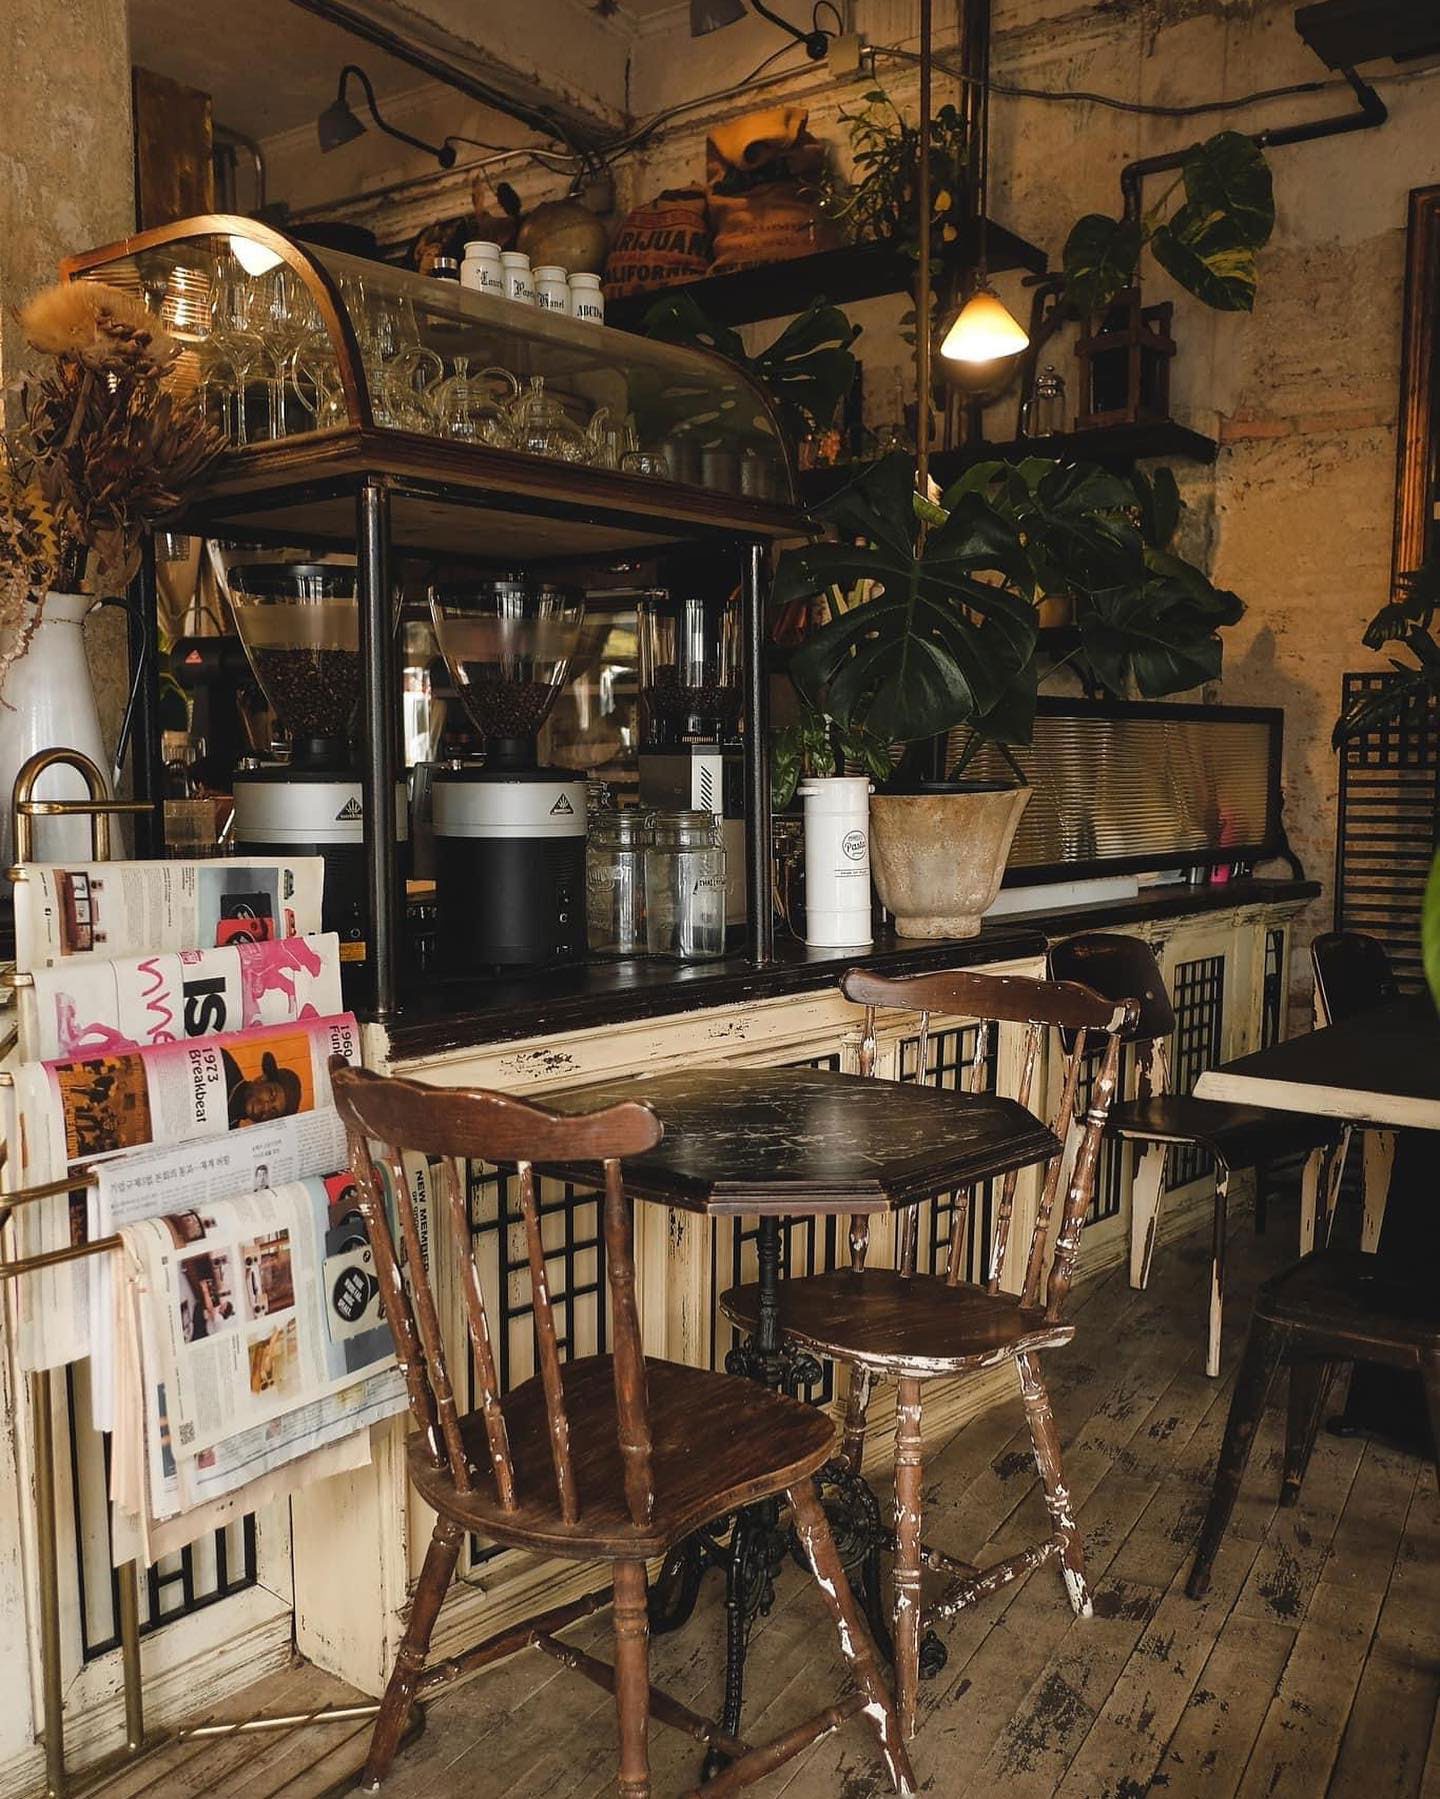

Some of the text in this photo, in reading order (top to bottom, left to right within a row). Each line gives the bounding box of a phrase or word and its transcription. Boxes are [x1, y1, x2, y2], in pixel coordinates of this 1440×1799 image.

[340, 1025, 354, 1057] 1960
[202, 1047, 219, 1083] 1973
[189, 1049, 207, 1122] Breakbeat
[416, 1170, 426, 1203] NEW
